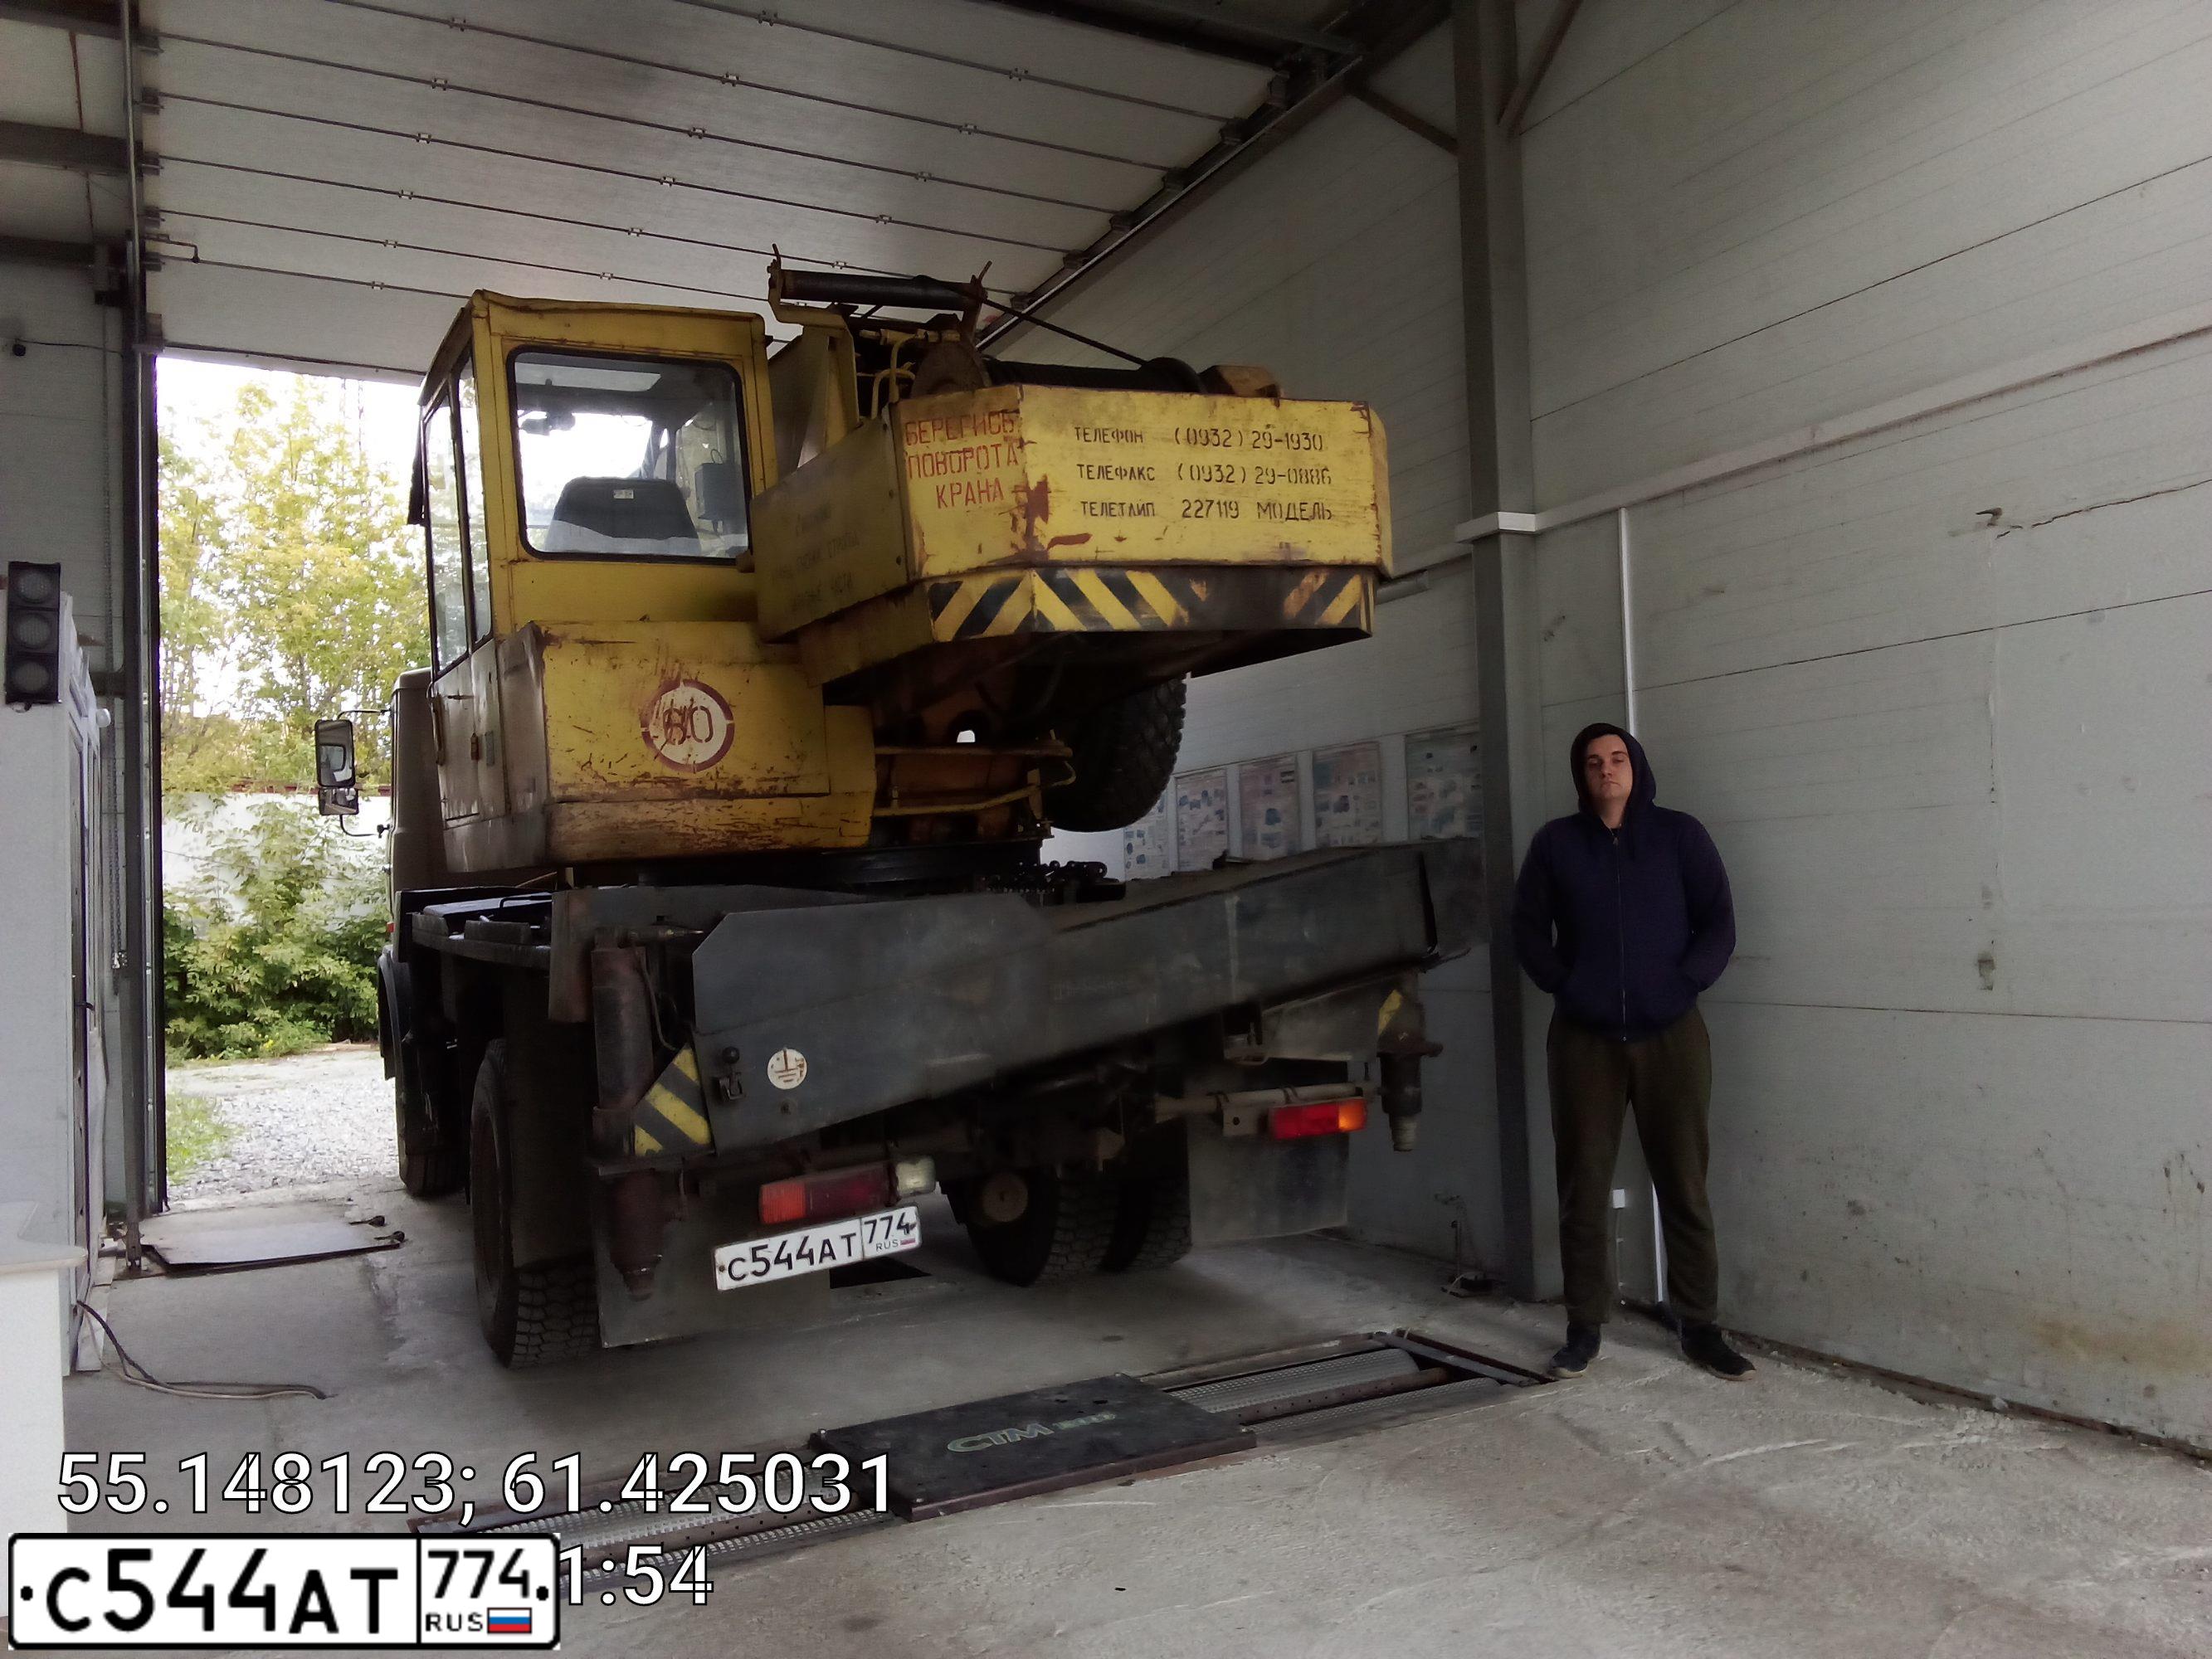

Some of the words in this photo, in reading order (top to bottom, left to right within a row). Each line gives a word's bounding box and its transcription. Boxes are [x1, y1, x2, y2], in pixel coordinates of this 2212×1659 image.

[1074, 426, 1143, 444] ТЕЛЕФОН
[1252, 430, 1323, 450] 29-1930
[907, 443, 1019, 479] ПОВОРОТА
[1077, 463, 1156, 481] ТЕЛЕФАКС
[936, 477, 1004, 509] КРАНА
[1182, 499, 1240, 519] 227119
[1257, 502, 1332, 521] МОДЕЛЬ
[864, 1212, 911, 1243] 774
[875, 1238, 899, 1252] RUS
